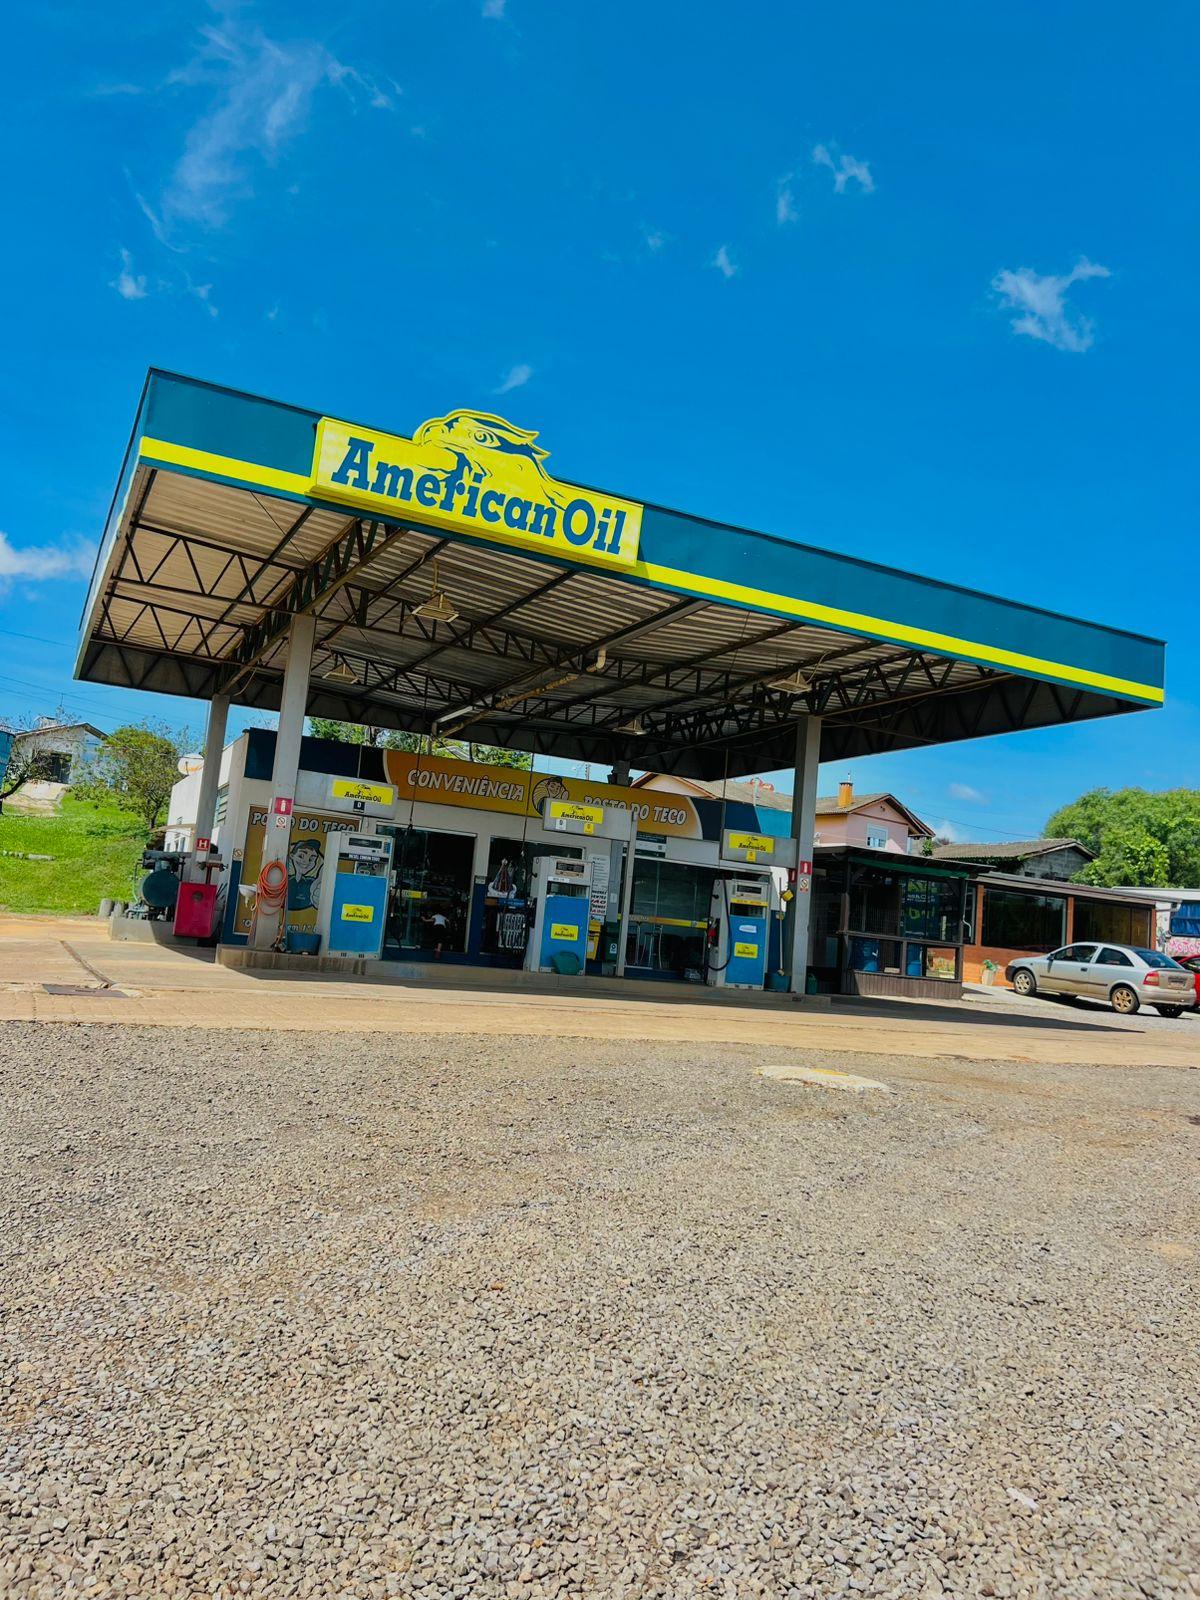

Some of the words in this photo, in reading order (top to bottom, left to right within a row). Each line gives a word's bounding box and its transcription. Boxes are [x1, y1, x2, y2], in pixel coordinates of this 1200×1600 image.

[331, 436, 556, 538] American
[562, 498, 627, 555] Oil
[407, 768, 525, 802] CONVENIÊNCIA
[299, 818, 319, 832] DO
[653, 806, 687, 825] TECO
[199, 839, 208, 848] H
